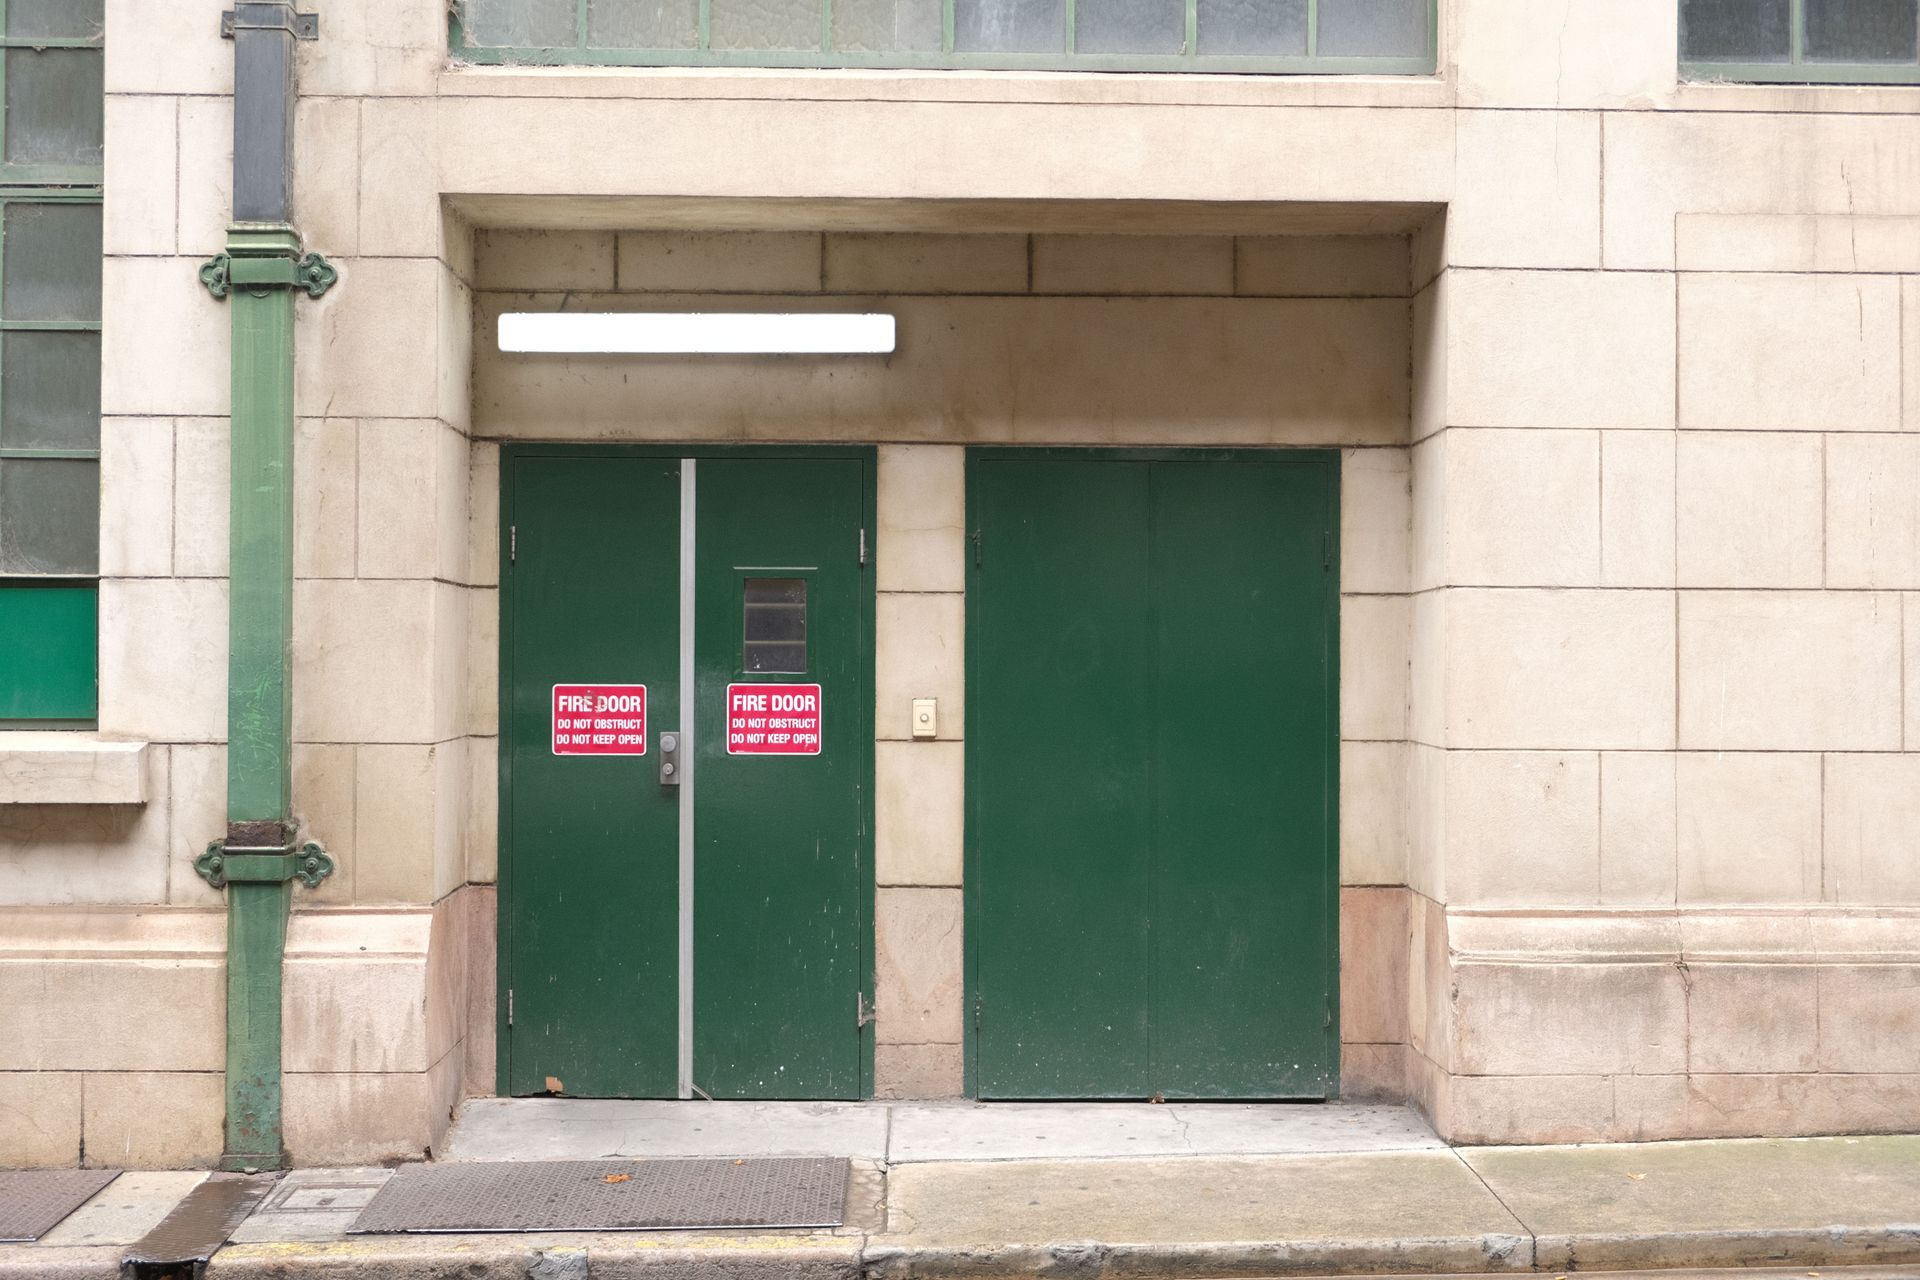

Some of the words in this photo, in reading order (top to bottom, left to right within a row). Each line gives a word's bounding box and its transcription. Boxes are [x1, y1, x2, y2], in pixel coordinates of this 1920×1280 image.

[558, 695, 593, 712] FIRE
[597, 695, 641, 712] DOOR
[733, 694, 767, 712] FIRE
[771, 694, 816, 712] DOOR
[557, 718, 571, 730] DO
[573, 718, 592, 730] NOT
[594, 718, 642, 730] OBSTRUCT
[732, 717, 746, 729] DO
[747, 717, 767, 729] NOT
[768, 717, 816, 729] OBSTRUCT
[556, 734, 570, 745] DO
[572, 734, 591, 745] NOT
[593, 734, 616, 745] KEEP
[618, 734, 643, 745] OPEN
[731, 733, 745, 744] DO
[746, 733, 766, 744] NOT
[767, 733, 791, 744] KEEP
[792, 733, 817, 744] OPEN
